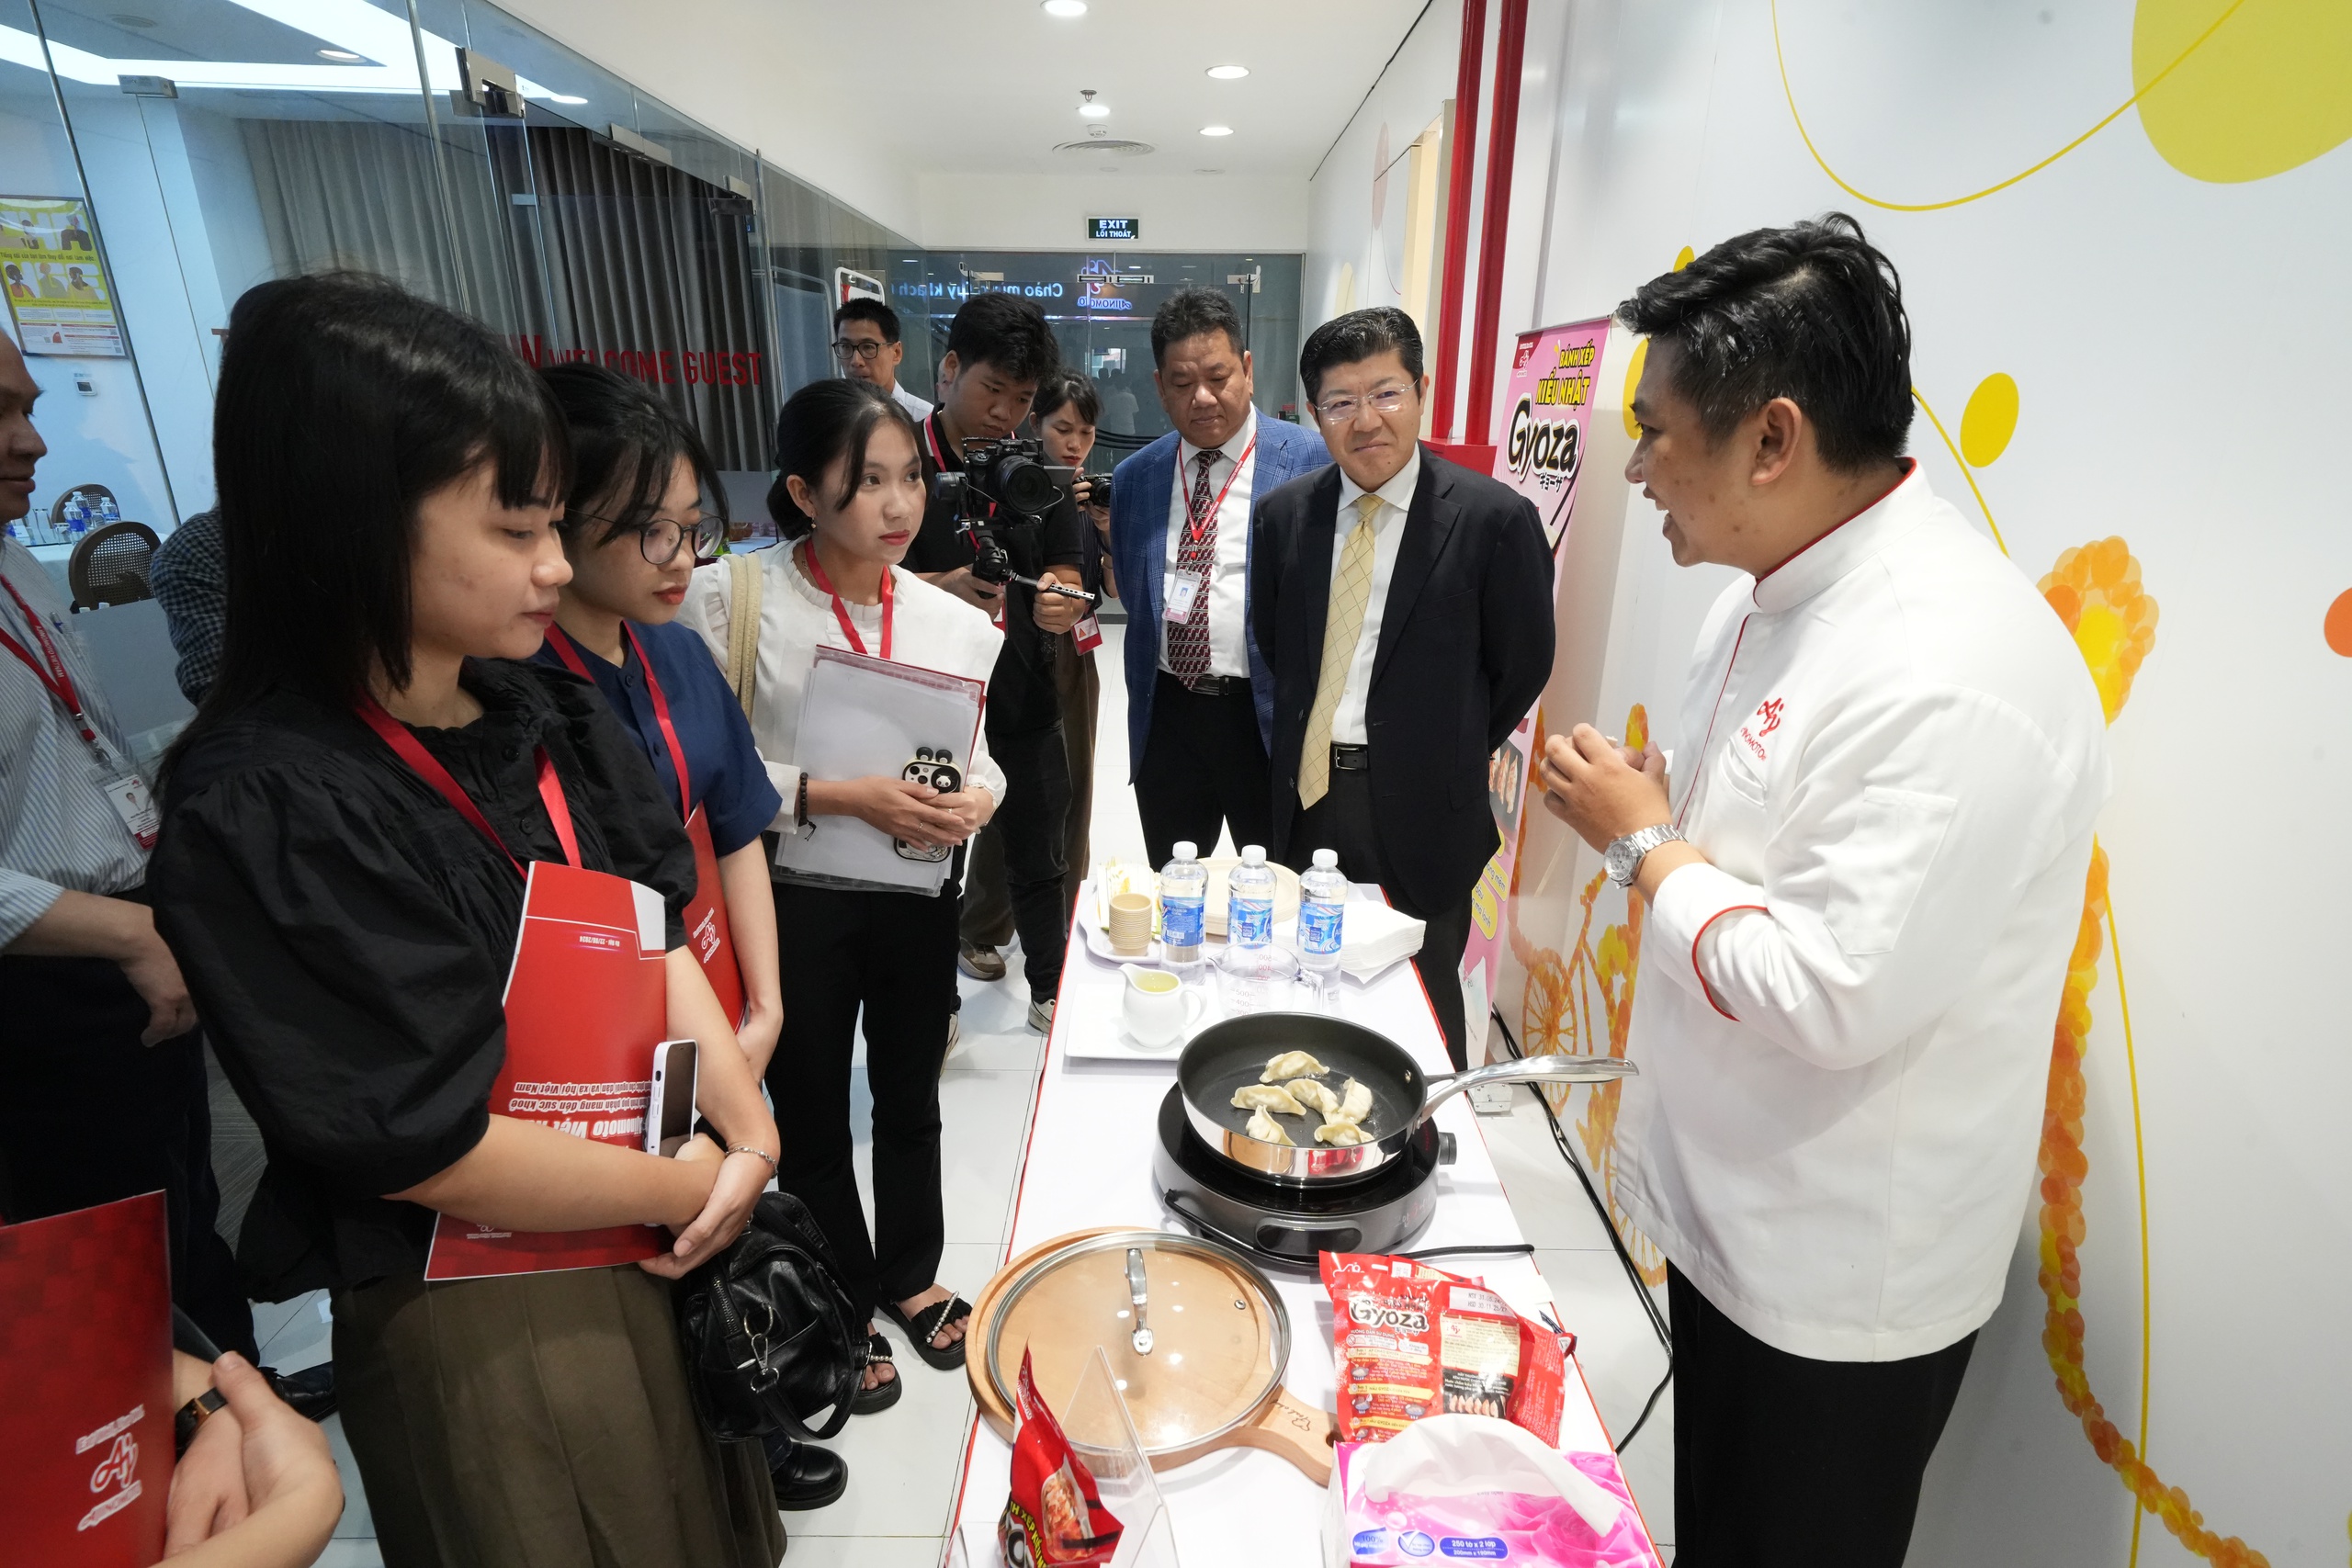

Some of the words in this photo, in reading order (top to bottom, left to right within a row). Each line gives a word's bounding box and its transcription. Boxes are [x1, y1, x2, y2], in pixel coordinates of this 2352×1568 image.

[1099, 220, 1128, 230] EXIT
[1109, 229, 1132, 238] THOÁT
[1558, 344, 1579, 368] BÁNH
[1580, 338, 1595, 367] XẾP
[683, 352, 762, 385] GUEST
[1535, 367, 1559, 405] KIỂU
[1558, 369, 1591, 412] NHẬT
[1508, 395, 1579, 480] Gyoza
[514, 1082, 538, 1093] Nam
[539, 1081, 559, 1095] Việt
[561, 1081, 577, 1095] hội
[590, 1083, 600, 1095] và
[539, 1100, 557, 1112] sức
[560, 1099, 577, 1114] đến
[580, 1098, 604, 1111] mang
[1350, 1297, 1430, 1332] Gyoza
[1021, 1510, 1035, 1532] XẾP
[1031, 1531, 1042, 1559] KIỂU
[1362, 1534, 1383, 1544] 100%
[1451, 1540, 1465, 1548] 250
